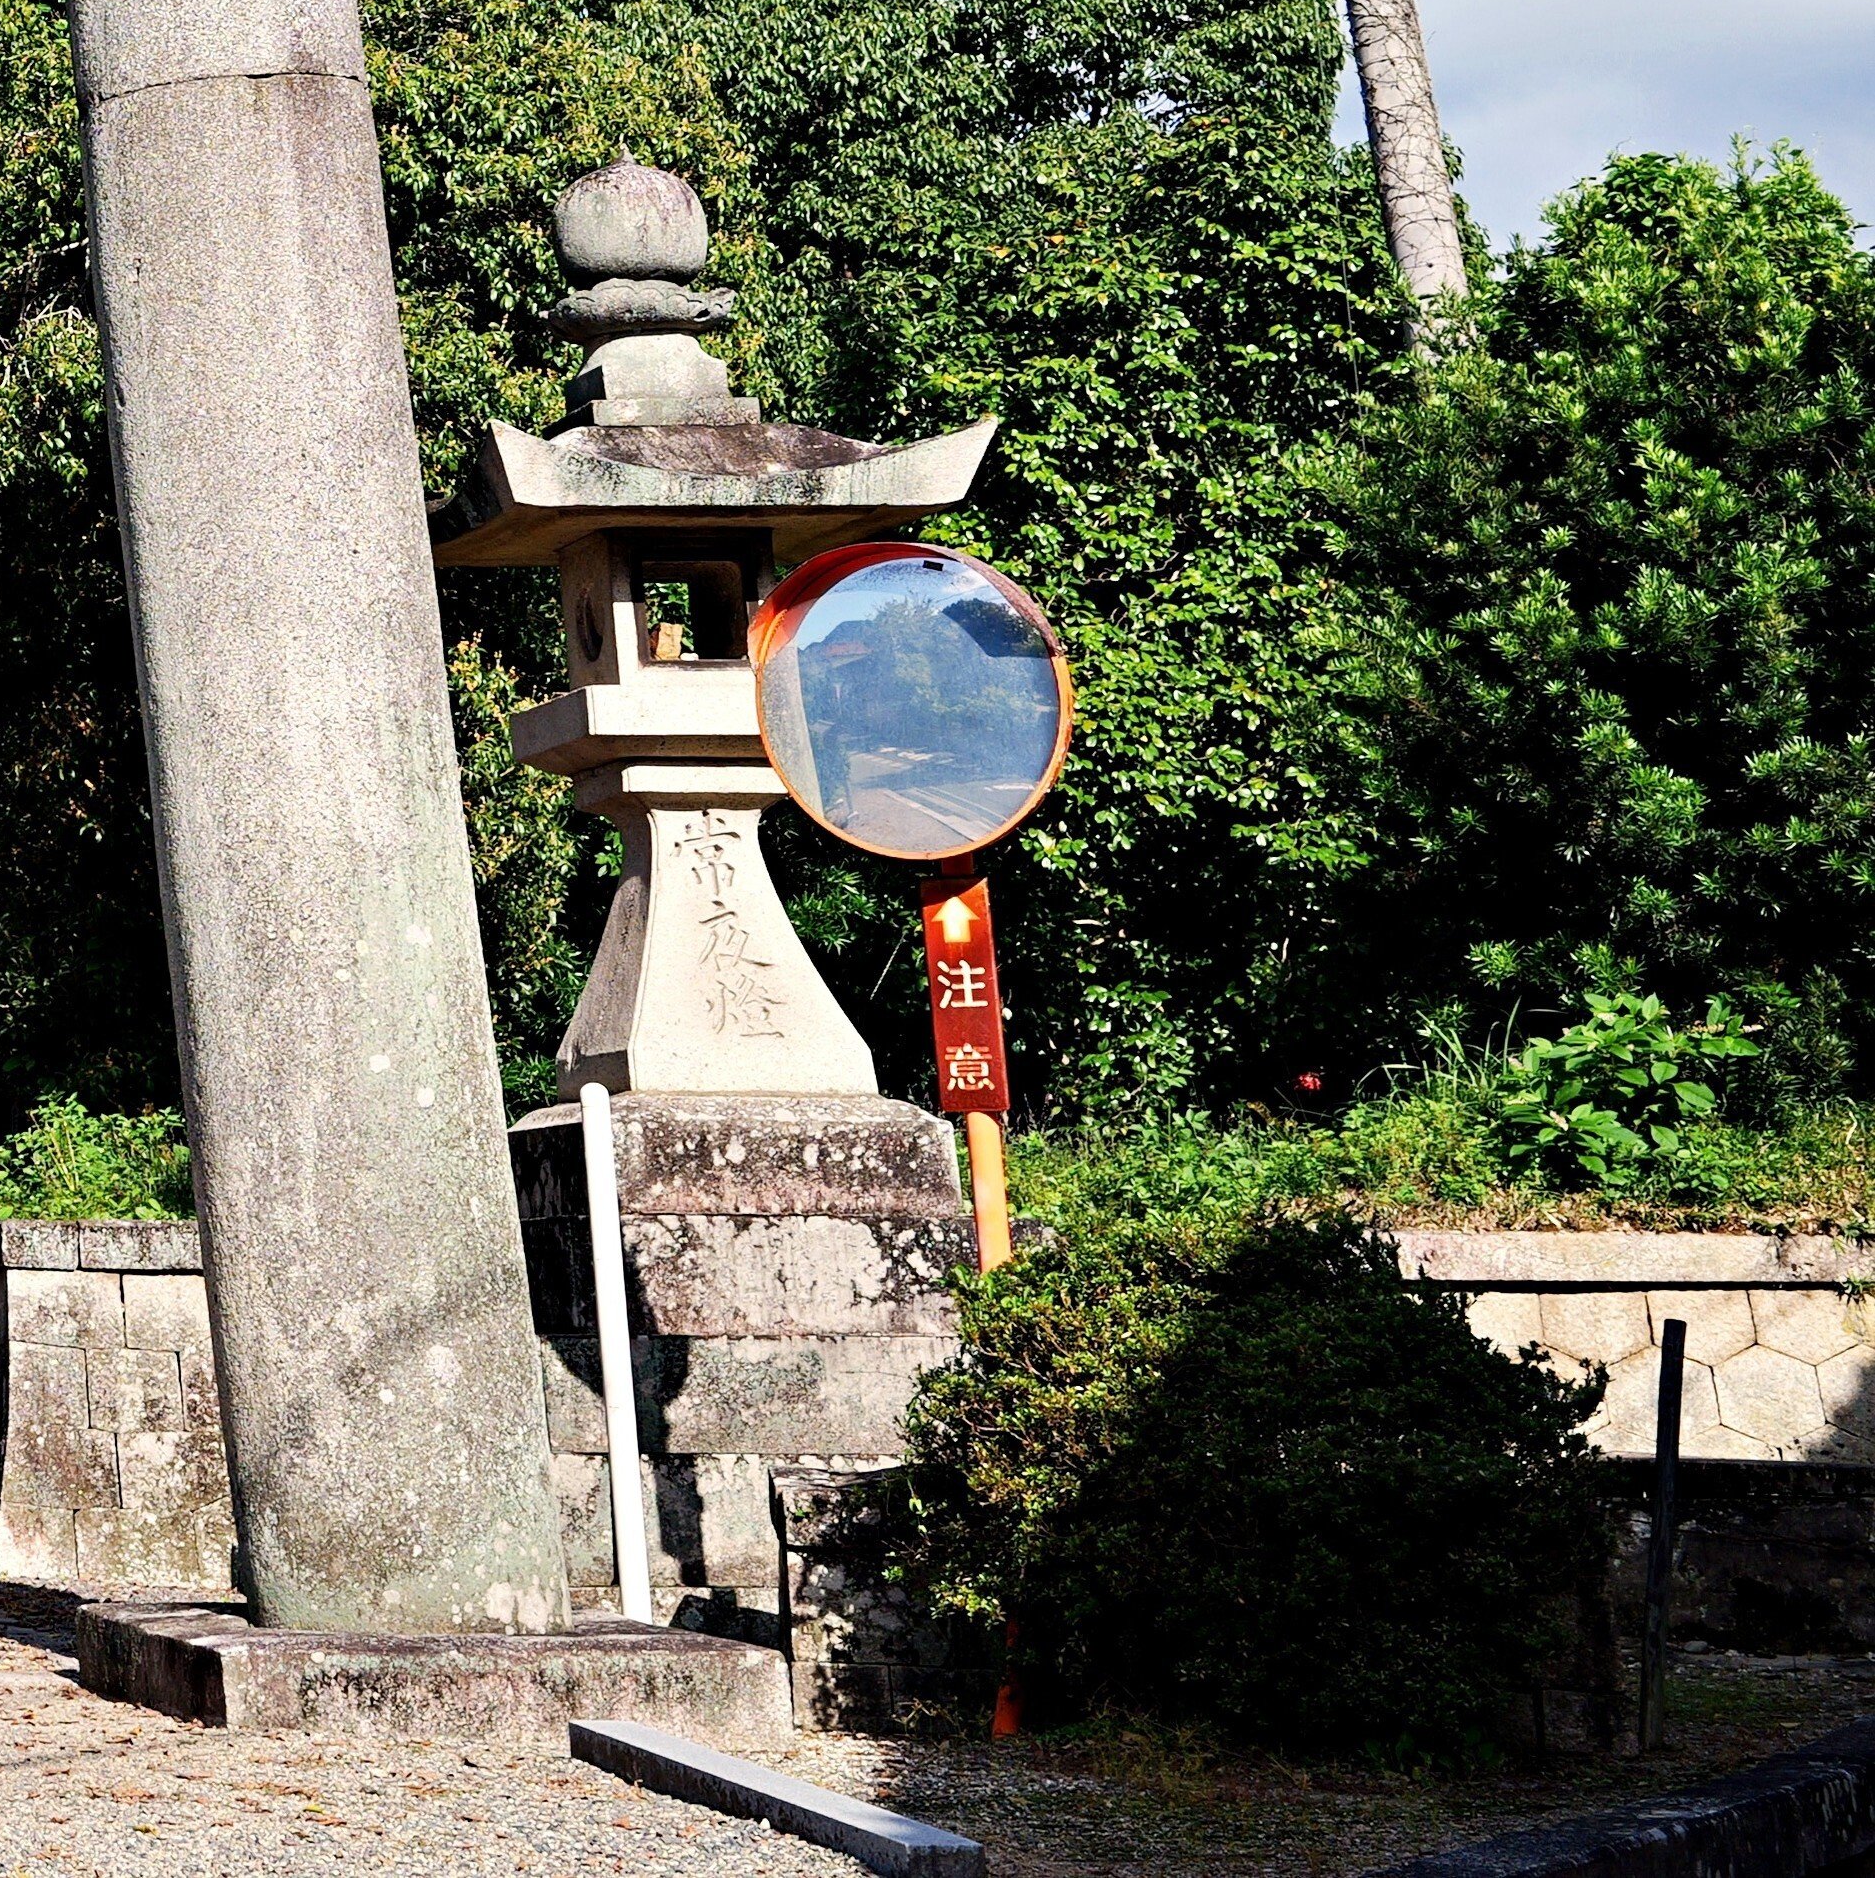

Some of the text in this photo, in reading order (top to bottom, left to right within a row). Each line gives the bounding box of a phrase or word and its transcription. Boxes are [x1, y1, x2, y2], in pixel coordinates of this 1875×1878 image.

[670, 810, 786, 1038] 常夜燈
[937, 960, 995, 1090] 注意
